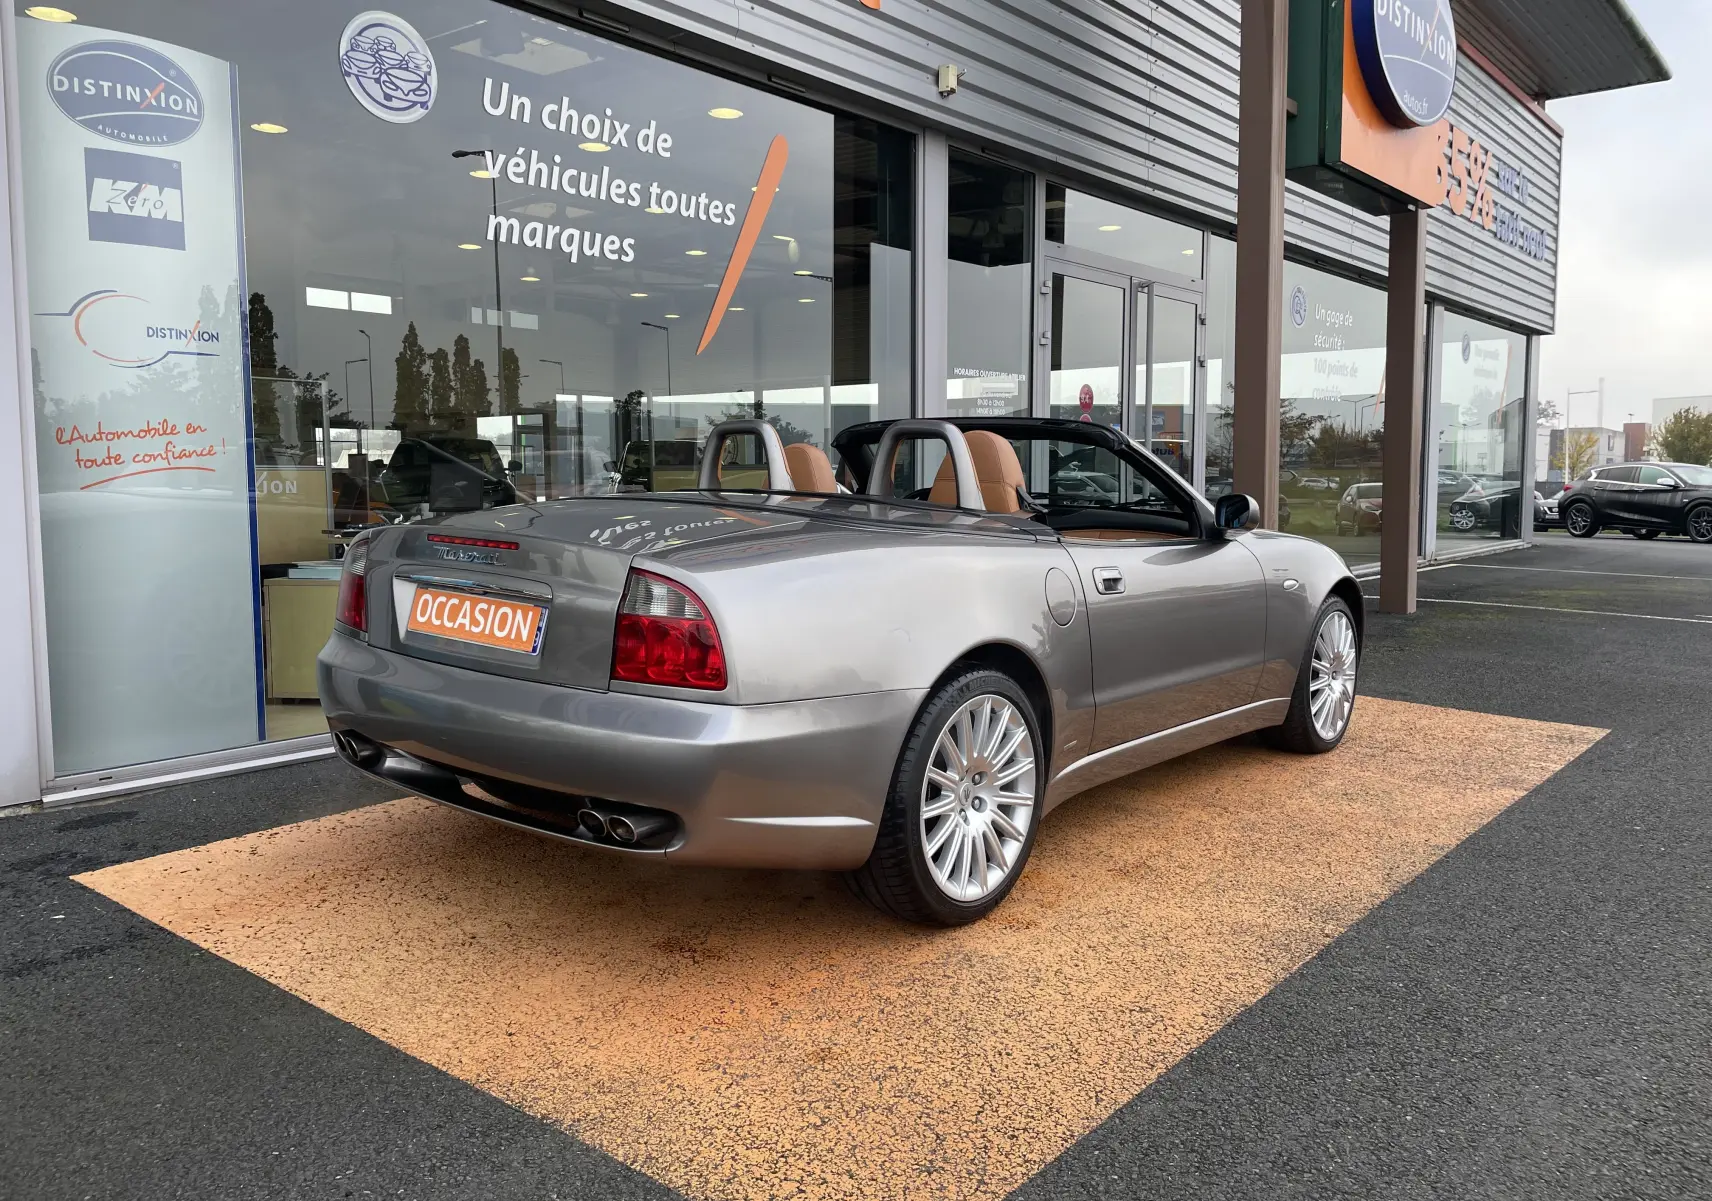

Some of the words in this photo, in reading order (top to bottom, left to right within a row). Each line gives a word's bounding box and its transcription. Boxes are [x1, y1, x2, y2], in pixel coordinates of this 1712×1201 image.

[1377, 0, 1454, 69] DISTINXION
[53, 74, 199, 117] DISTINXION
[483, 77, 532, 124] Un
[541, 96, 630, 149] choix
[637, 120, 673, 158] de
[97, 124, 169, 142] AUTOMOBILE
[483, 147, 641, 207] véhicules
[648, 181, 737, 226] toutes
[486, 213, 636, 264] marques
[1314, 303, 1325, 321] Un
[1326, 308, 1344, 328] gage
[1344, 310, 1353, 327] de
[146, 322, 220, 345] DISTINXION
[953, 367, 979, 377] HORAIRES
[1313, 357, 1327, 374] 100
[1327, 359, 1349, 379] points
[1349, 361, 1358, 379] de
[56, 418, 181, 446] l'Automobile
[186, 421, 207, 435] en
[75, 446, 125, 470] toute
[132, 440, 217, 467] confiance
[416, 593, 533, 642] OCCASION
